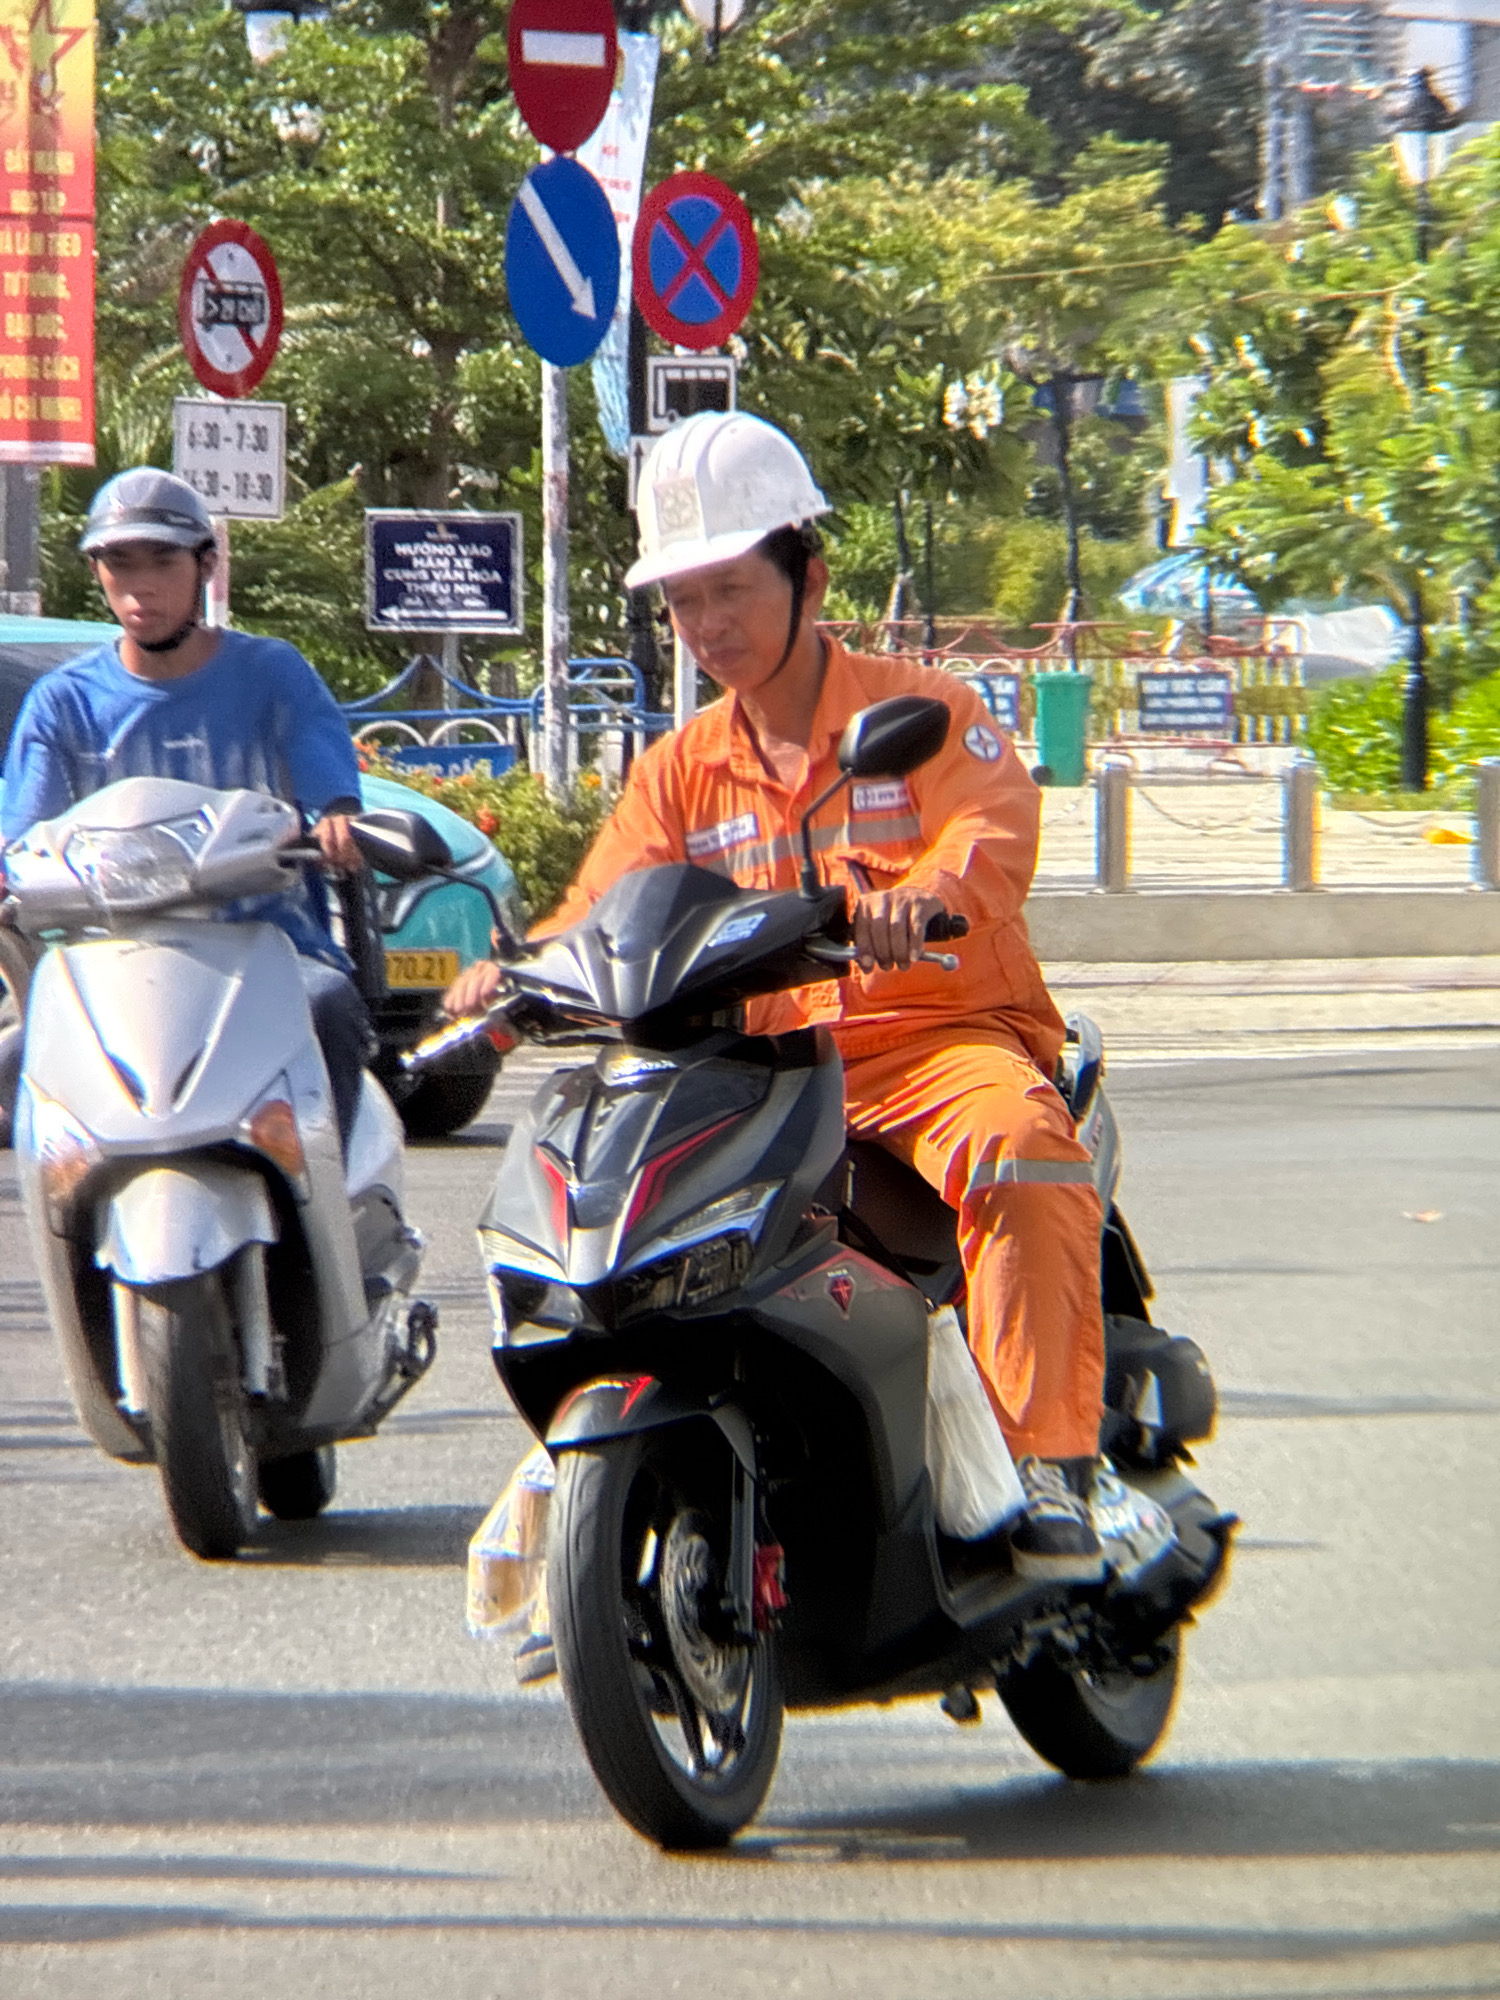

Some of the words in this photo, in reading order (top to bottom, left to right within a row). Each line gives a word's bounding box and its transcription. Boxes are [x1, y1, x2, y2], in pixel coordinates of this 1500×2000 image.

[187, 421, 220, 450] 6:30
[237, 422, 270, 453] 7:30
[384, 955, 447, 982] 70.21
